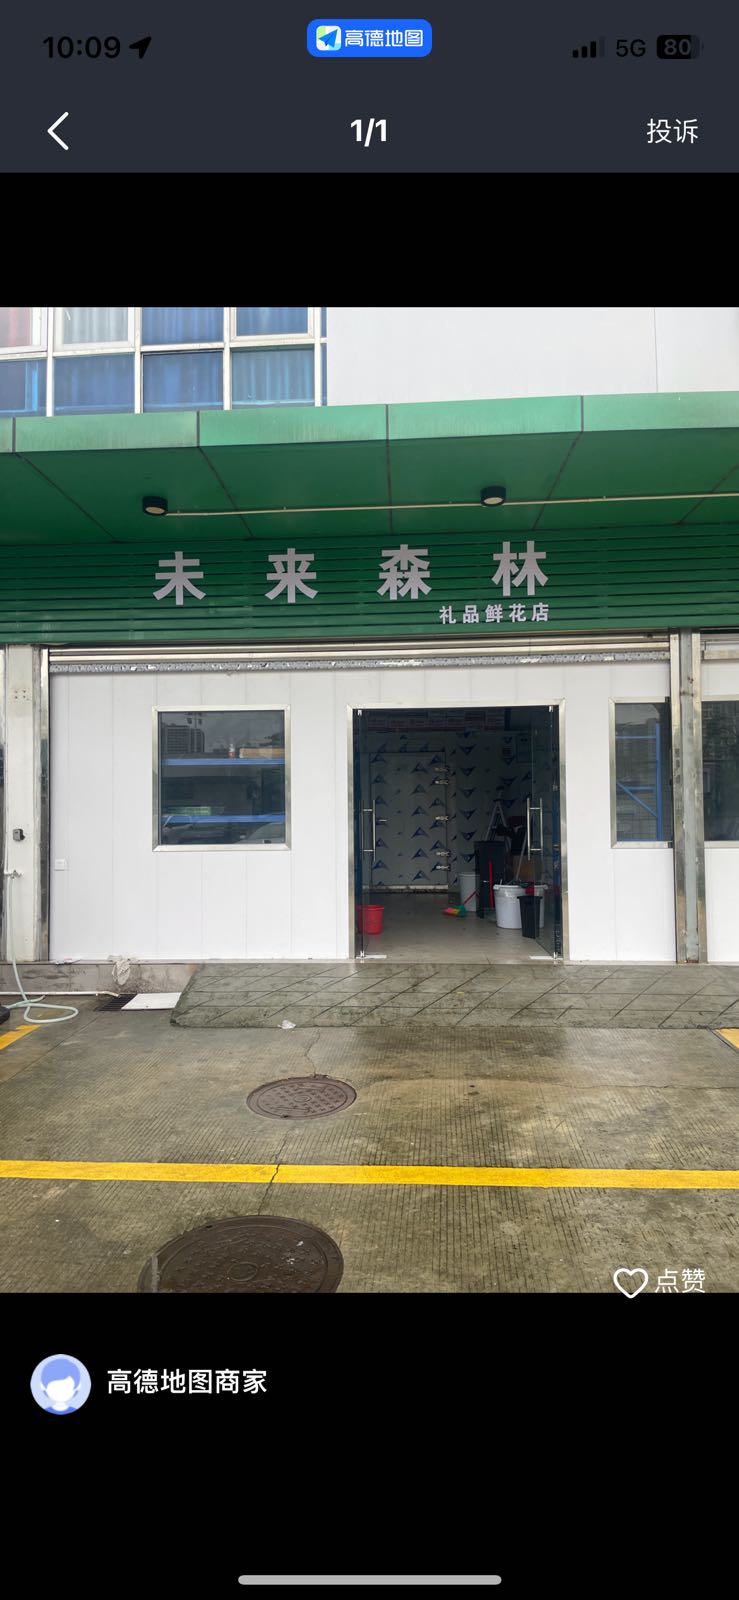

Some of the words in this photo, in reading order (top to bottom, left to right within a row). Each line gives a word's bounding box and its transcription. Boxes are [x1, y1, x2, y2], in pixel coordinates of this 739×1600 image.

[153, 541, 549, 606] 未来森林
[439, 602, 550, 625] 礼品鲜花店
